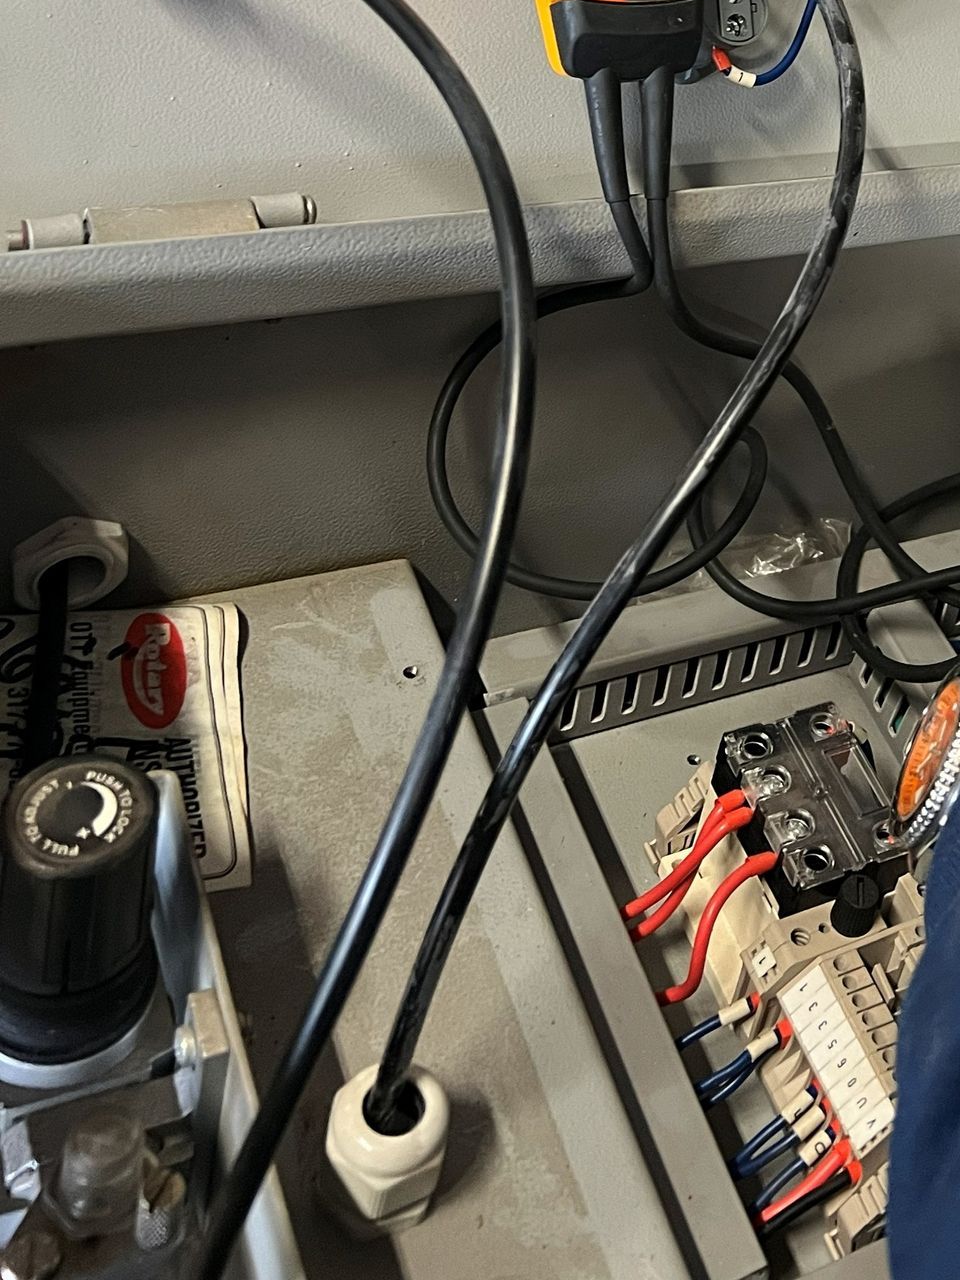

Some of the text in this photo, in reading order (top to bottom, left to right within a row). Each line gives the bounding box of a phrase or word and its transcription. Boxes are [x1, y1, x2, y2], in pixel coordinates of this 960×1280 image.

[85, 770, 134, 844] PUSH TO LOCK
[42, 838, 80, 857] PULL
